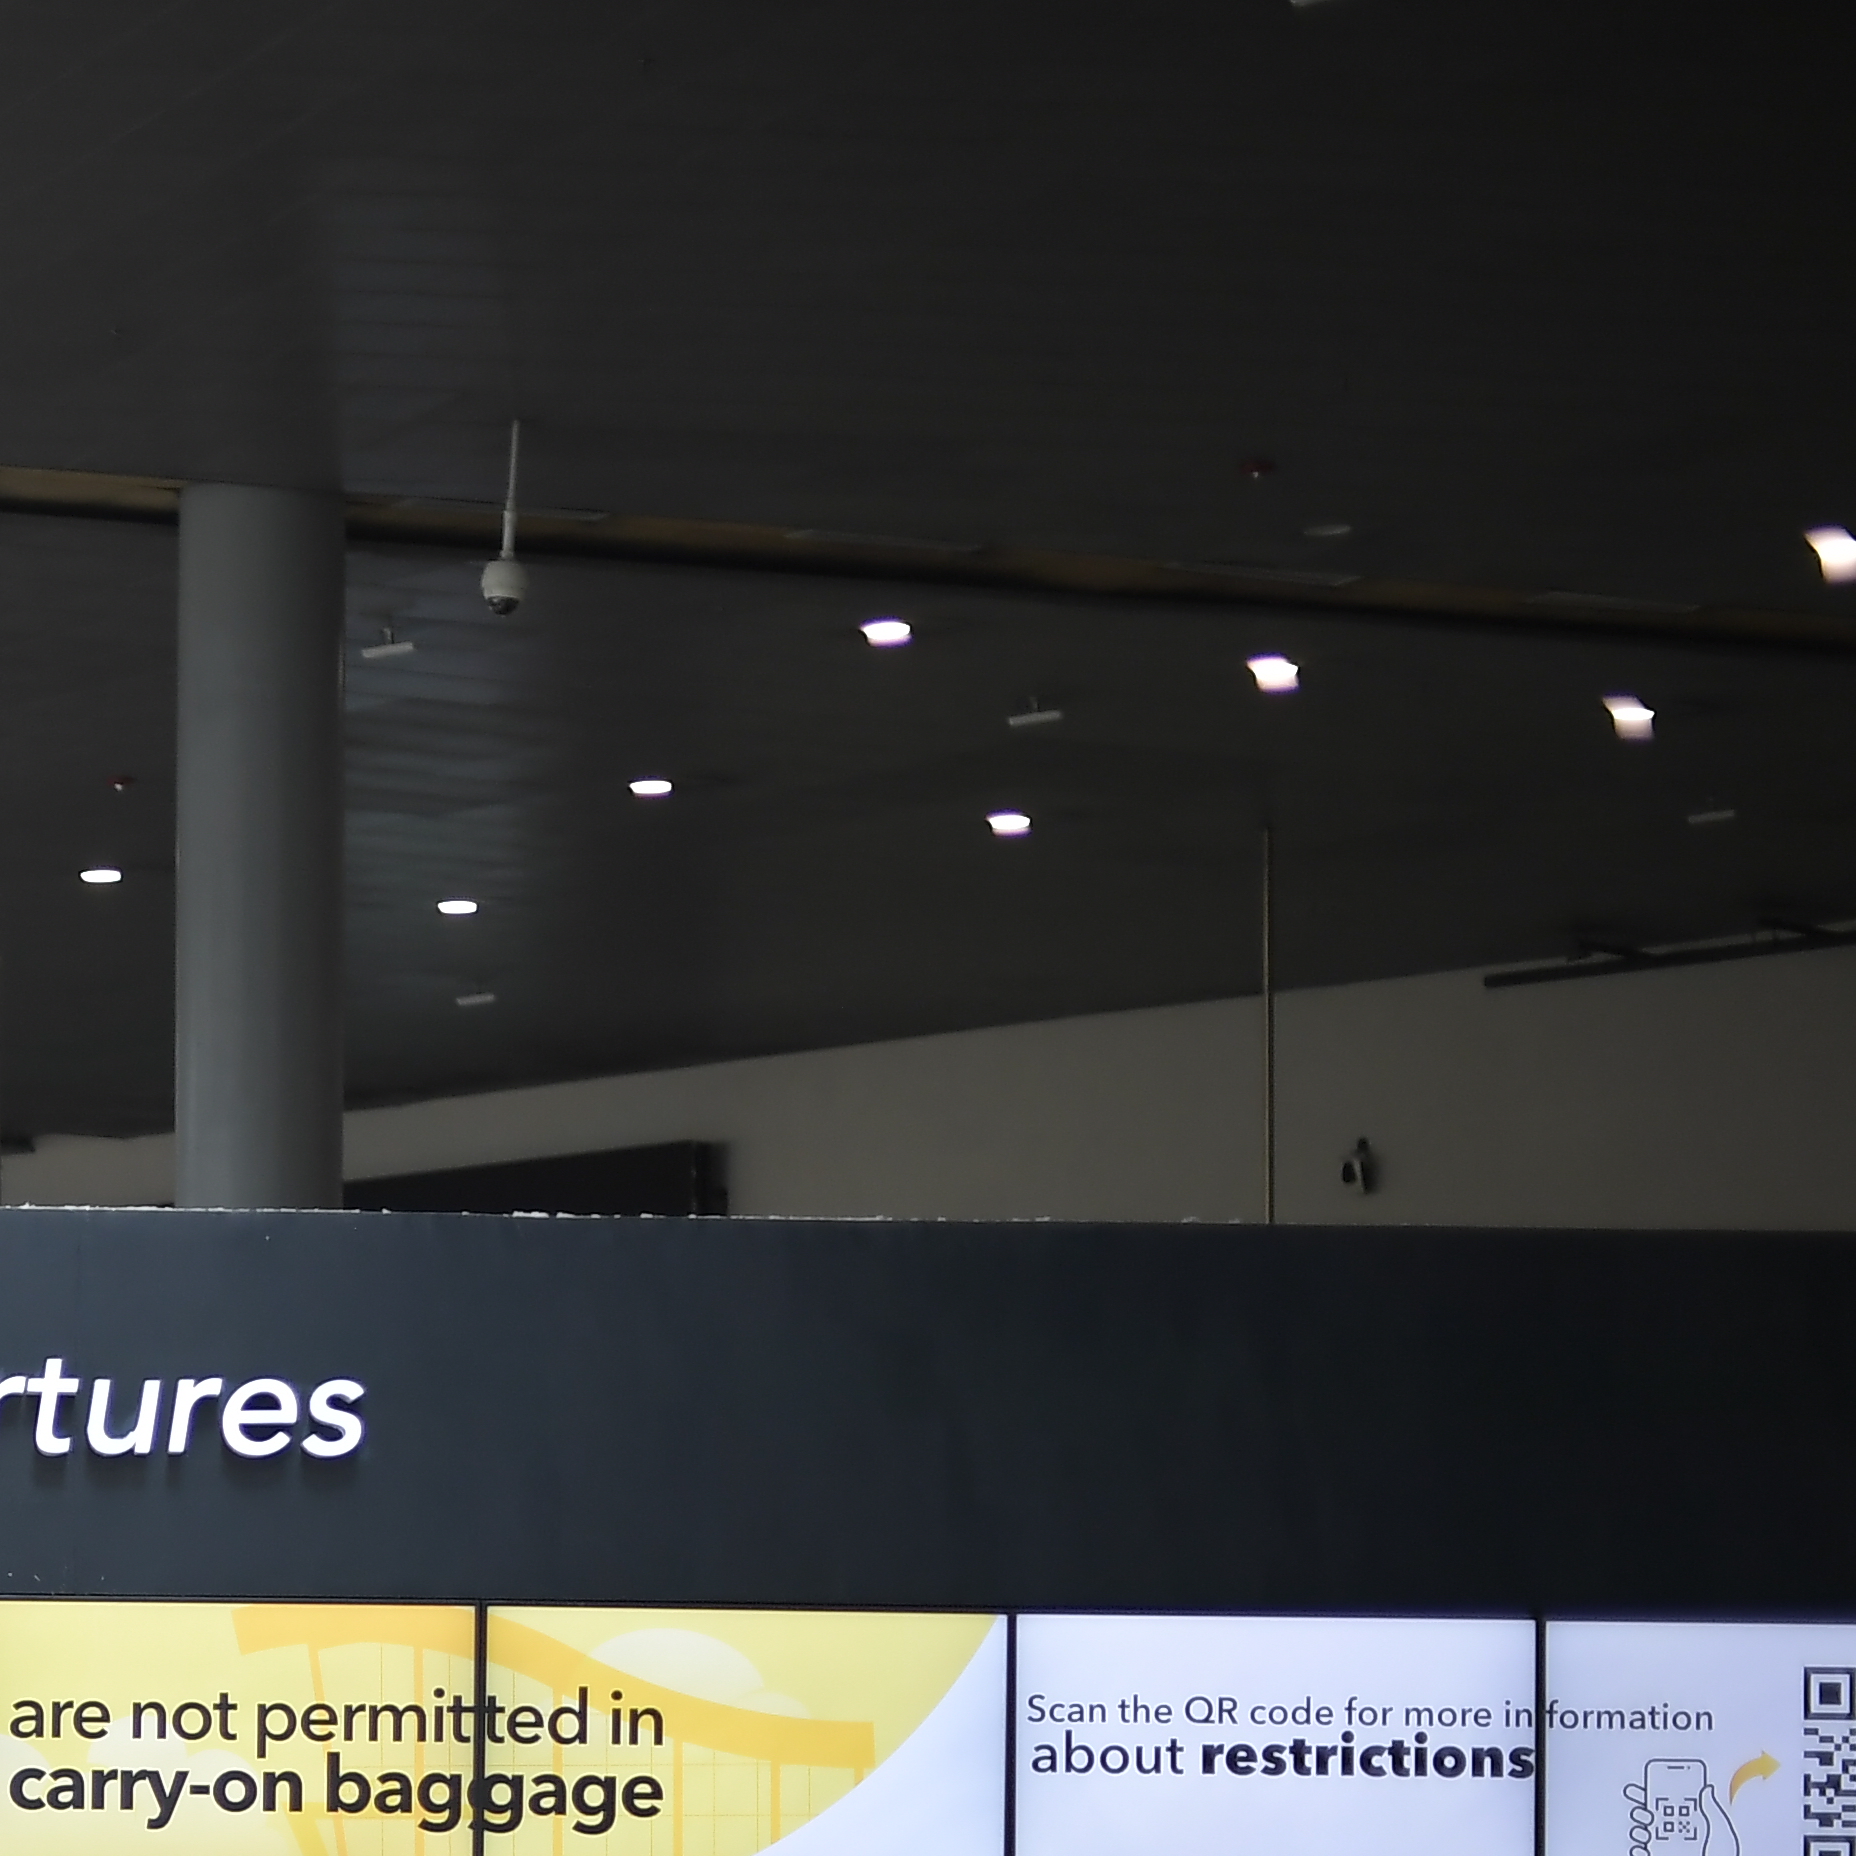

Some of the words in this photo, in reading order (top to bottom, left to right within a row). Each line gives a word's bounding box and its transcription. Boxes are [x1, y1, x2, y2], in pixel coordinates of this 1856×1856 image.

[10, 1695, 111, 1741] are
[132, 1692, 238, 1742] not
[257, 1687, 589, 1760] permitted
[611, 1690, 665, 1747] in
[1027, 1695, 1107, 1725] Scan
[1117, 1696, 1174, 1726] the
[1184, 1697, 1239, 1729] QR
[1250, 1696, 1336, 1727] code
[1345, 1697, 1391, 1728] for
[1403, 1705, 1493, 1729] more
[1504, 1698, 1715, 1732] information
[1031, 1732, 1185, 1777] about
[1201, 1733, 1537, 1780] restrictions
[9, 1764, 302, 1830] carry-on
[325, 1752, 665, 1835] baggage
